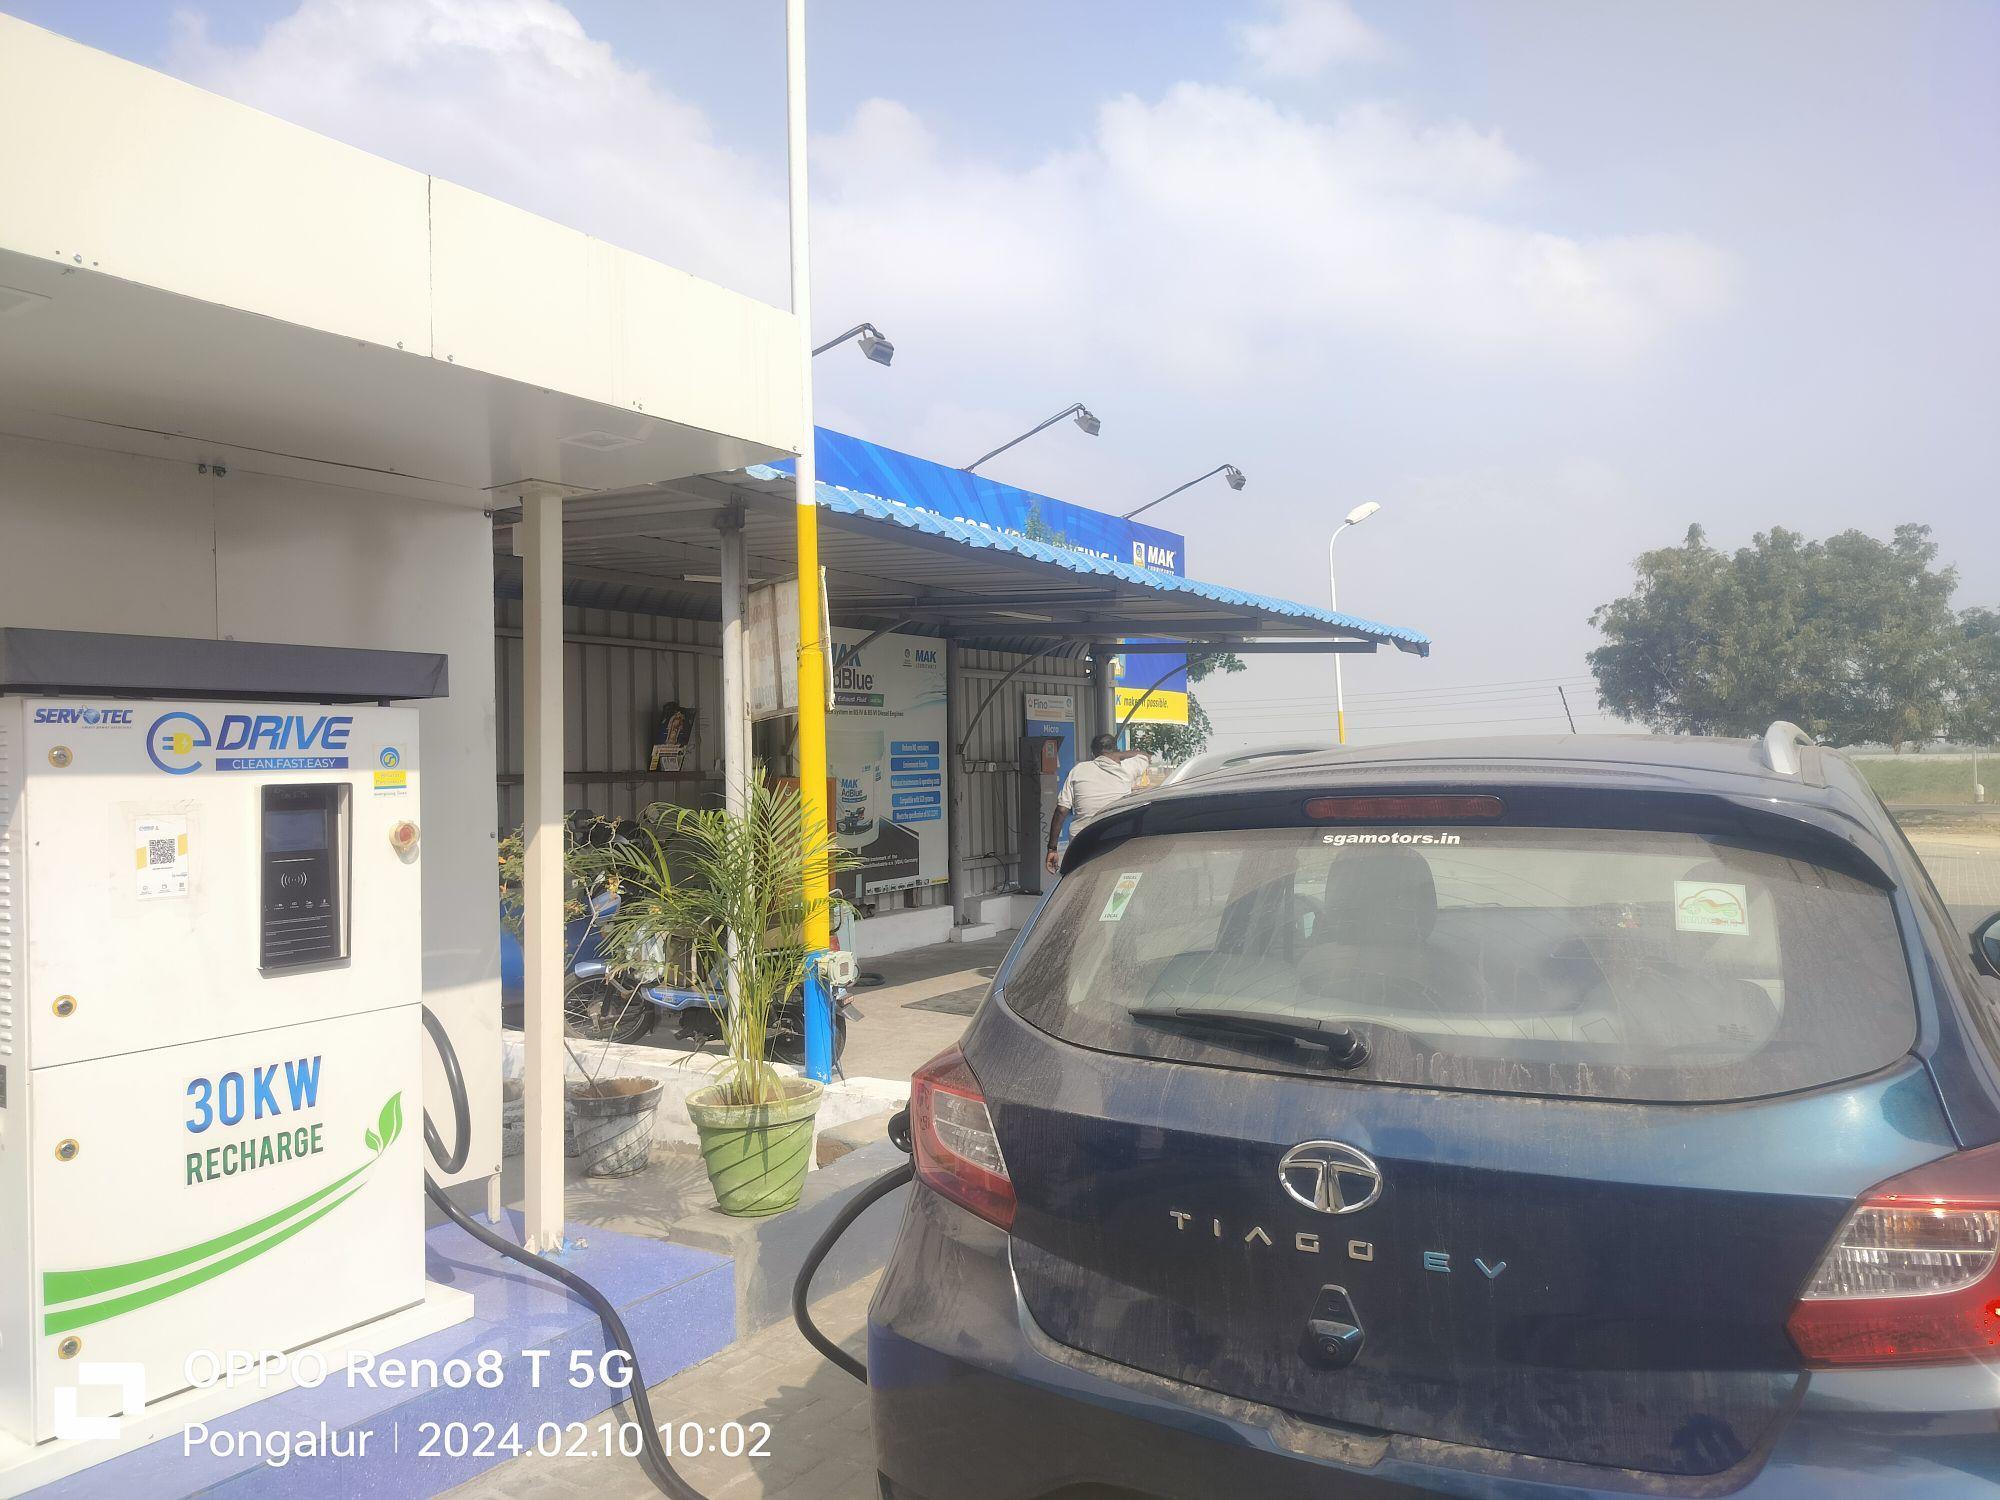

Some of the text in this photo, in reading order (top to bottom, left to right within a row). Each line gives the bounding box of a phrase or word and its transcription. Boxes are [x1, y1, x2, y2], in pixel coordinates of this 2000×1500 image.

[1148, 545, 1175, 569] MAK
[916, 649, 937, 663] MAK
[1033, 698, 1048, 709] Fino
[216, 715, 353, 751] DRIVE
[1043, 724, 1059, 733] Micro
[232, 758, 336, 770] CLEAN.FAST.EASY
[1322, 832, 1461, 846] sgamotors.in
[186, 1123, 324, 1186] RECHARGE
[1169, 1210, 1507, 1279] TIAGO EV
